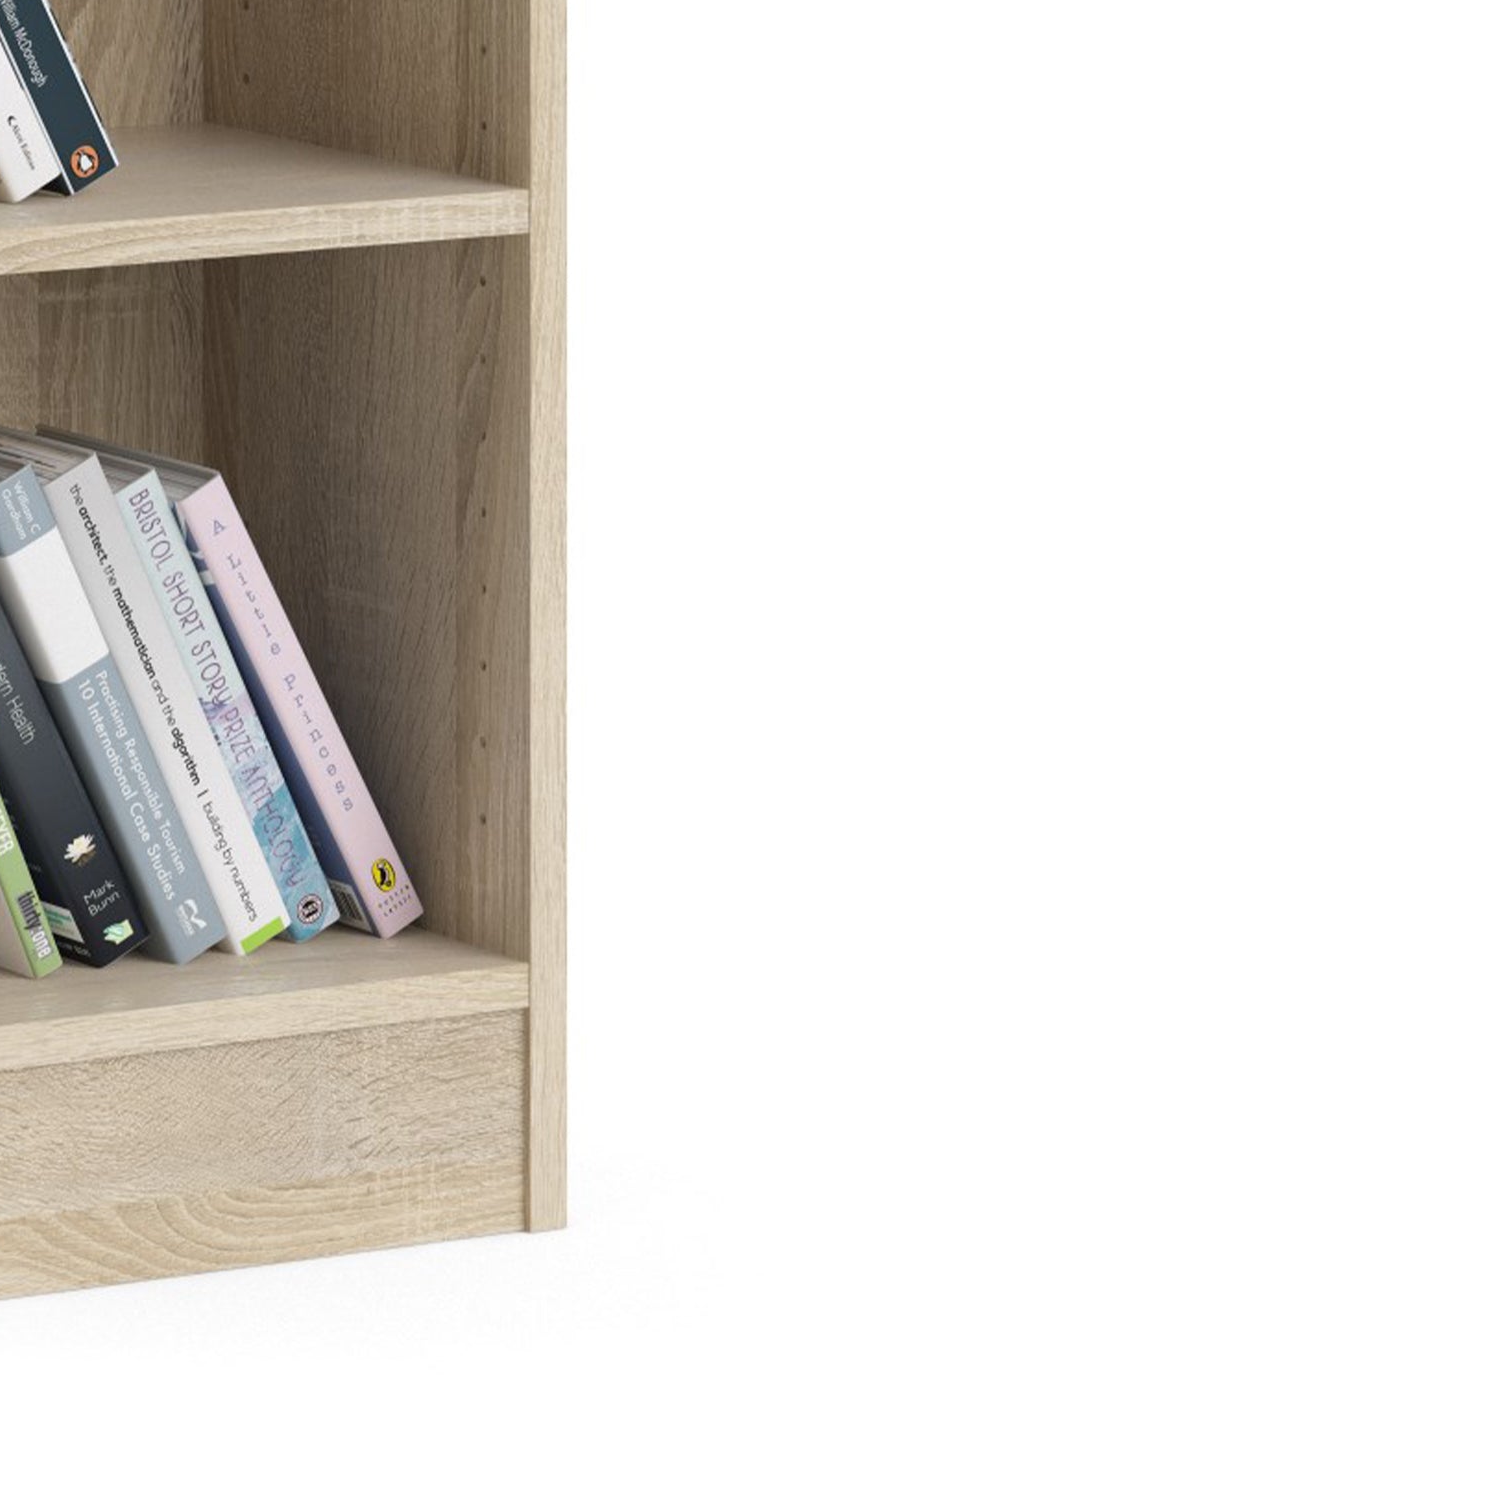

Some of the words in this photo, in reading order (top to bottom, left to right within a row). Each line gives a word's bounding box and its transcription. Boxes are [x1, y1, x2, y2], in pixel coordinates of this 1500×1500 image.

[14, 27, 49, 89] McDonough
[13, 480, 34, 523] William
[30, 523, 41, 535] C
[213, 519, 226, 536] A
[70, 483, 84, 506] the
[78, 506, 109, 566] architect,
[103, 563, 117, 586] the
[112, 587, 156, 680] mathematician
[151, 678, 167, 705] and
[161, 703, 177, 727] the
[171, 726, 201, 786] algorithm
[203, 802, 228, 851] building
[222, 846, 235, 866] by
[229, 864, 257, 923] numbers
[129, 488, 175, 572] BRISTOL
[162, 571, 206, 637] SHORT
[191, 639, 233, 705] STORY
[222, 707, 256, 763] PRIZE
[241, 763, 304, 888] ANTHOLOGY
[6, 695, 36, 745] Health
[79, 678, 95, 700] 10
[87, 701, 138, 801] International
[129, 801, 151, 843] Case
[146, 843, 177, 901] Studies
[95, 669, 128, 739] Practising
[124, 738, 162, 820] Responsible
[159, 819, 186, 876] Tourism
[83, 880, 115, 905] Mark
[87, 891, 120, 916] Bunn
